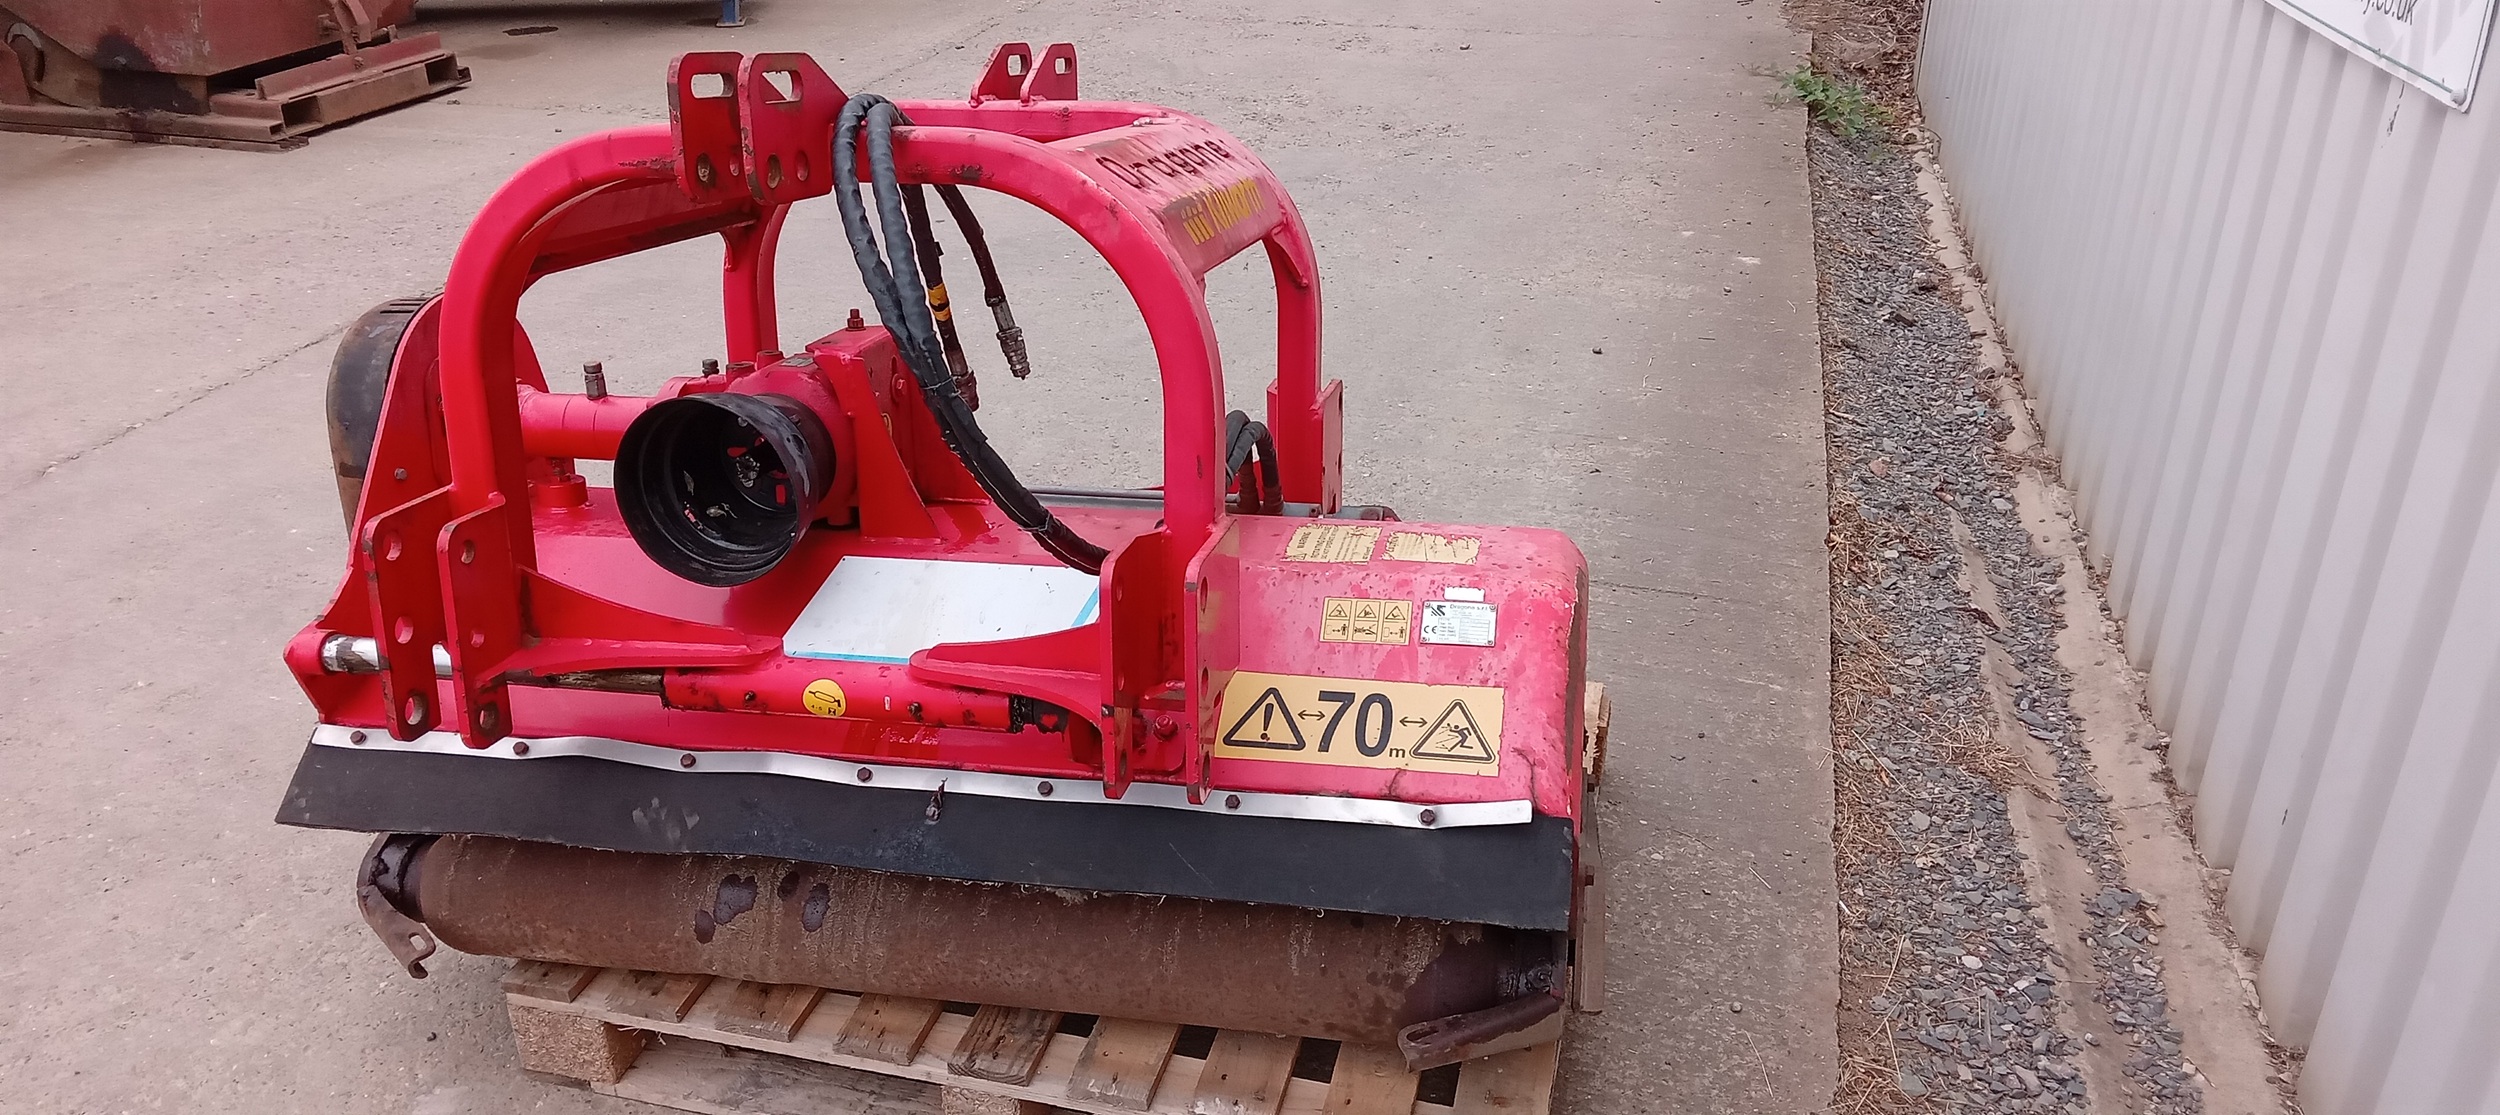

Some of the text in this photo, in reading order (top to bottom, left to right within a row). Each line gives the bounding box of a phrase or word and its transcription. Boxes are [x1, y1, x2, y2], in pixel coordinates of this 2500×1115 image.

[2358, 0, 2418, 26] y.co.uk
[1096, 139, 1231, 190] Dragone
[1317, 690, 1405, 758] 70 m
